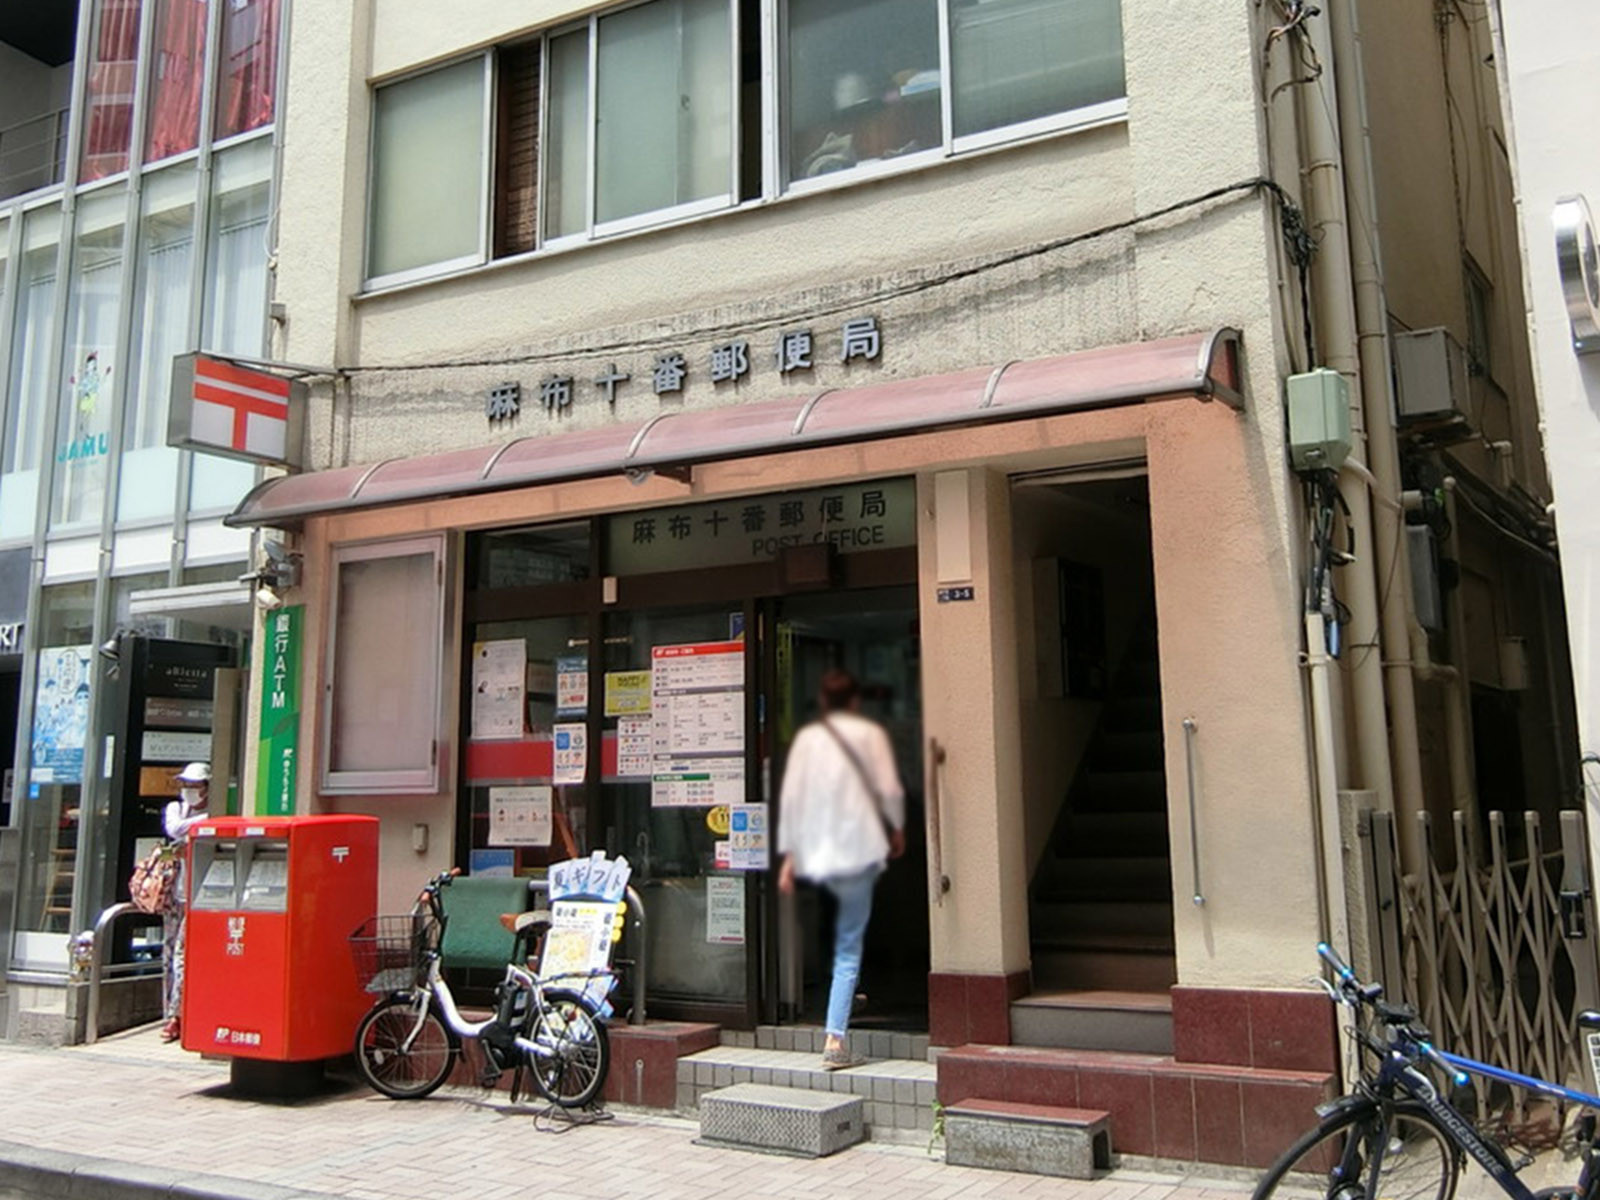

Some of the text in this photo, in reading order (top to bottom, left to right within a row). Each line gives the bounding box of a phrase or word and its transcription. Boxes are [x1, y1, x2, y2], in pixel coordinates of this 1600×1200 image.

[486, 317, 882, 419] 麻布十番郵便局
[632, 490, 887, 545] 麻布十番郵便局
[752, 533, 803, 556] POST
[271, 613, 290, 709] 銀行ATM
[553, 866, 623, 892] 夏ギフト
[1416, 1084, 1506, 1176] BRIDGESTONE
